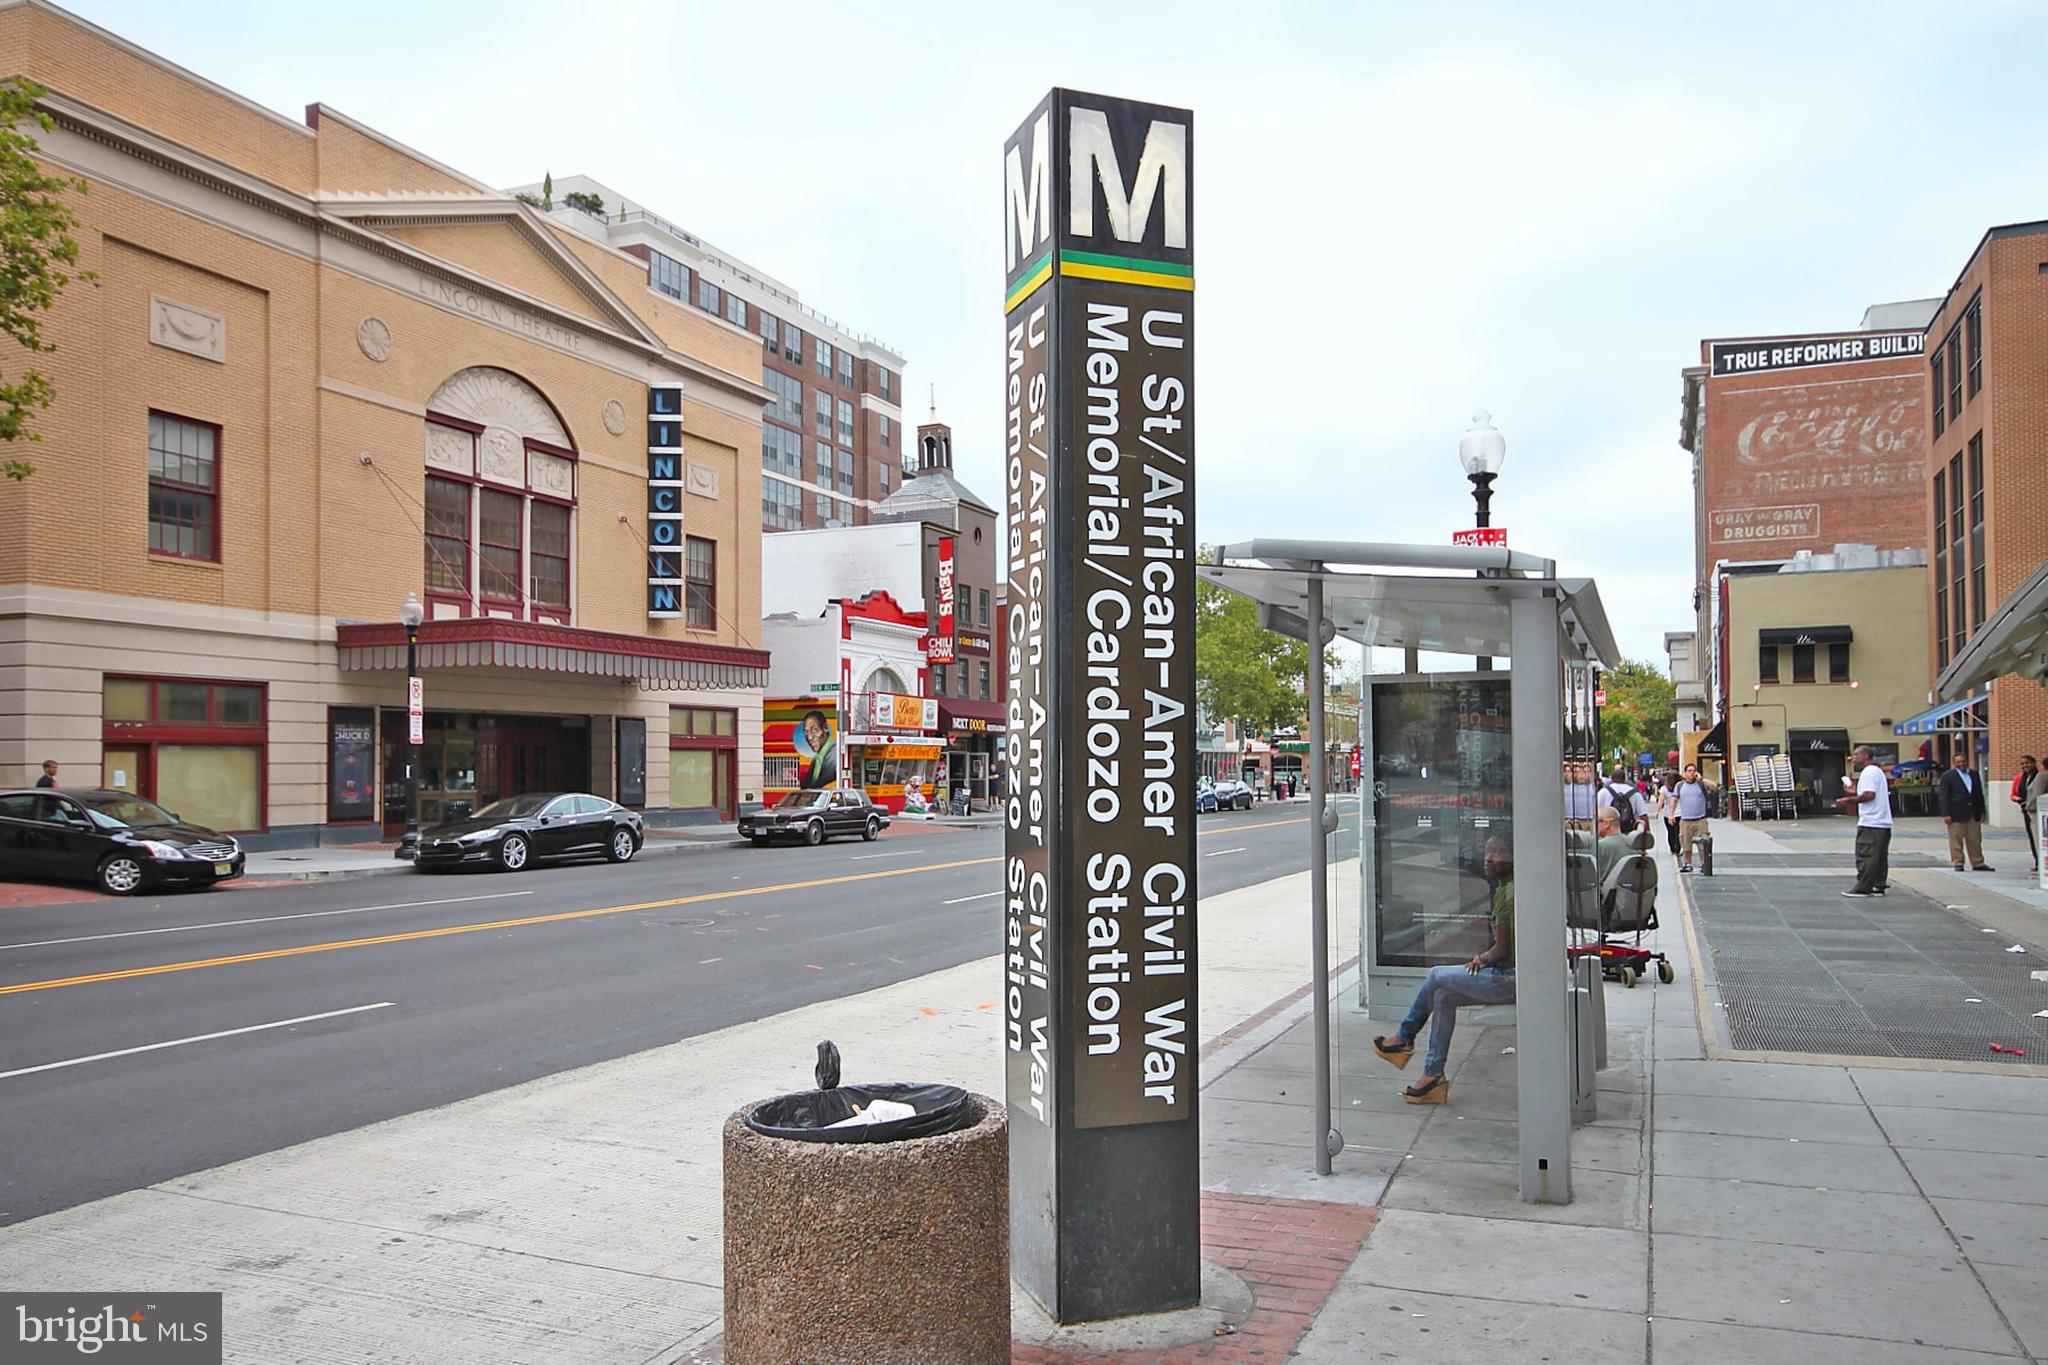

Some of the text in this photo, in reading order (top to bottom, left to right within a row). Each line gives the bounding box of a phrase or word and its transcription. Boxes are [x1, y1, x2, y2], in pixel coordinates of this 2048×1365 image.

[1006, 110, 1050, 275] M
[1069, 106, 1187, 250] M
[419, 278, 581, 351] LINCOLN THEATRE
[1028, 304, 1046, 349] U
[1723, 333, 1927, 371] TRUE REFORMER BUILDI
[653, 391, 675, 609] LINCOLN
[1715, 511, 1753, 525] GRAY
[1772, 508, 1814, 521] GRAY
[1723, 524, 1809, 540] DRUGGISTS
[1454, 533, 1479, 545] JACK
[939, 557, 954, 616] BEN'S
[928, 637, 953, 649] CHILI
[928, 648, 954, 658] BOWL
[1007, 320, 1027, 1052] Memorial/Cardozo Station
[1082, 303, 1134, 1056] Memorial/Cardozo Station
[1136, 308, 1187, 1105] U St/African-Amer Civil War
[969, 718, 986, 731] DOOR
[1028, 871, 1048, 990] Civil
[1029, 1016, 1049, 1123] War
